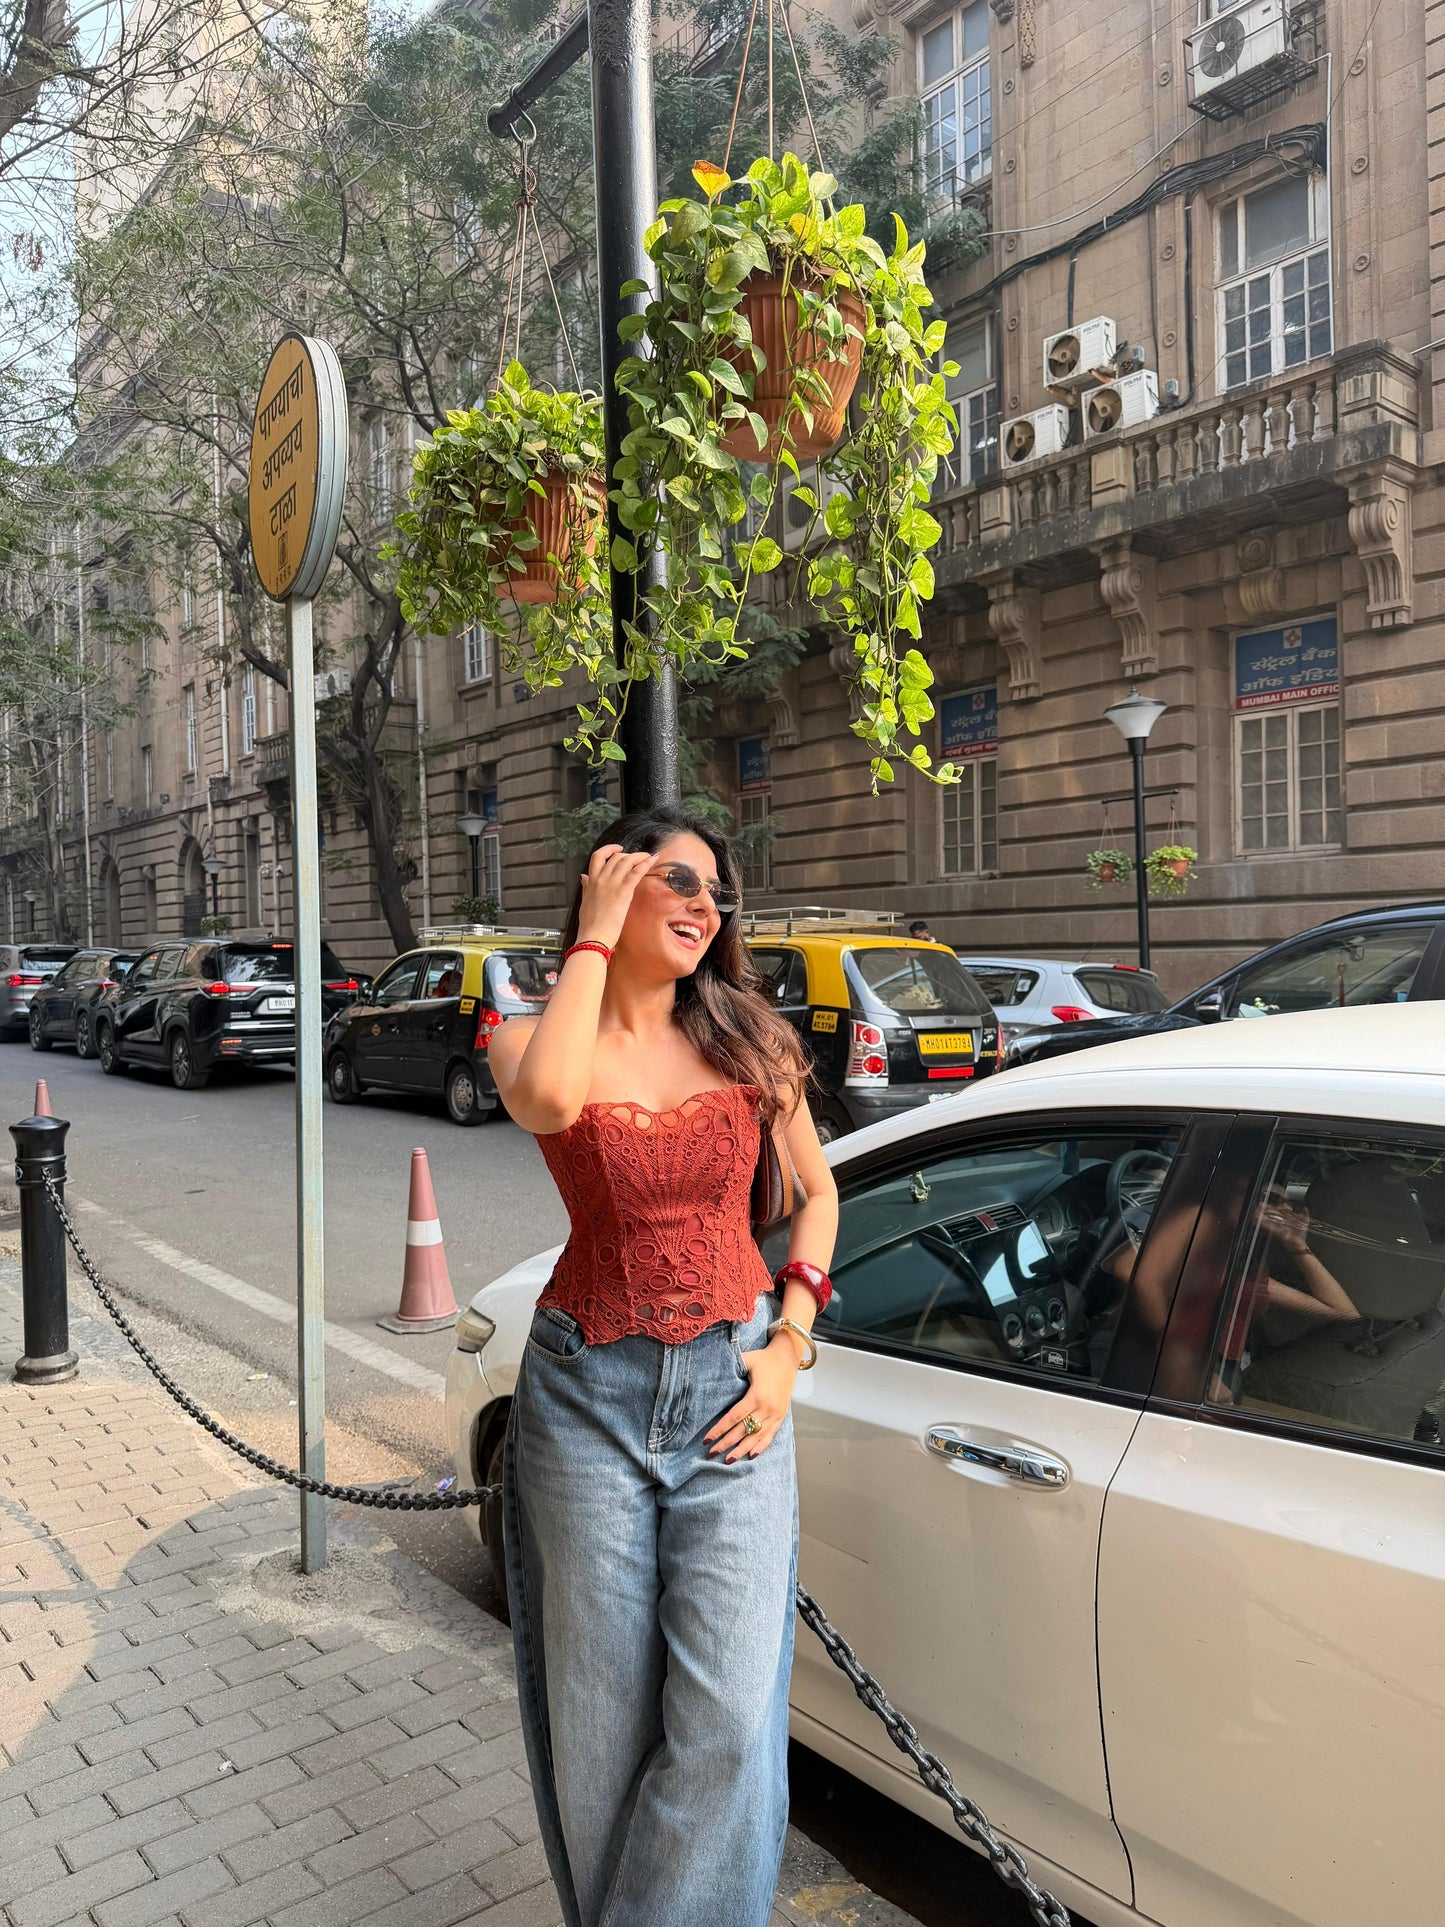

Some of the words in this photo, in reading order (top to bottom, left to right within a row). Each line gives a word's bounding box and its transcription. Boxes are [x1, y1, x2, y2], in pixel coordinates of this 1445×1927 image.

[259, 359, 304, 441] पाण्याचा
[262, 418, 303, 491] अपव्यय
[269, 481, 297, 537] टाळा
[1241, 677, 1285, 691] ऑफ
[1290, 668, 1338, 684] इंडिय
[1241, 696, 1280, 707] MUMBAI
[1282, 688, 1308, 700] MAIN
[1310, 684, 1339, 696] OFFIC
